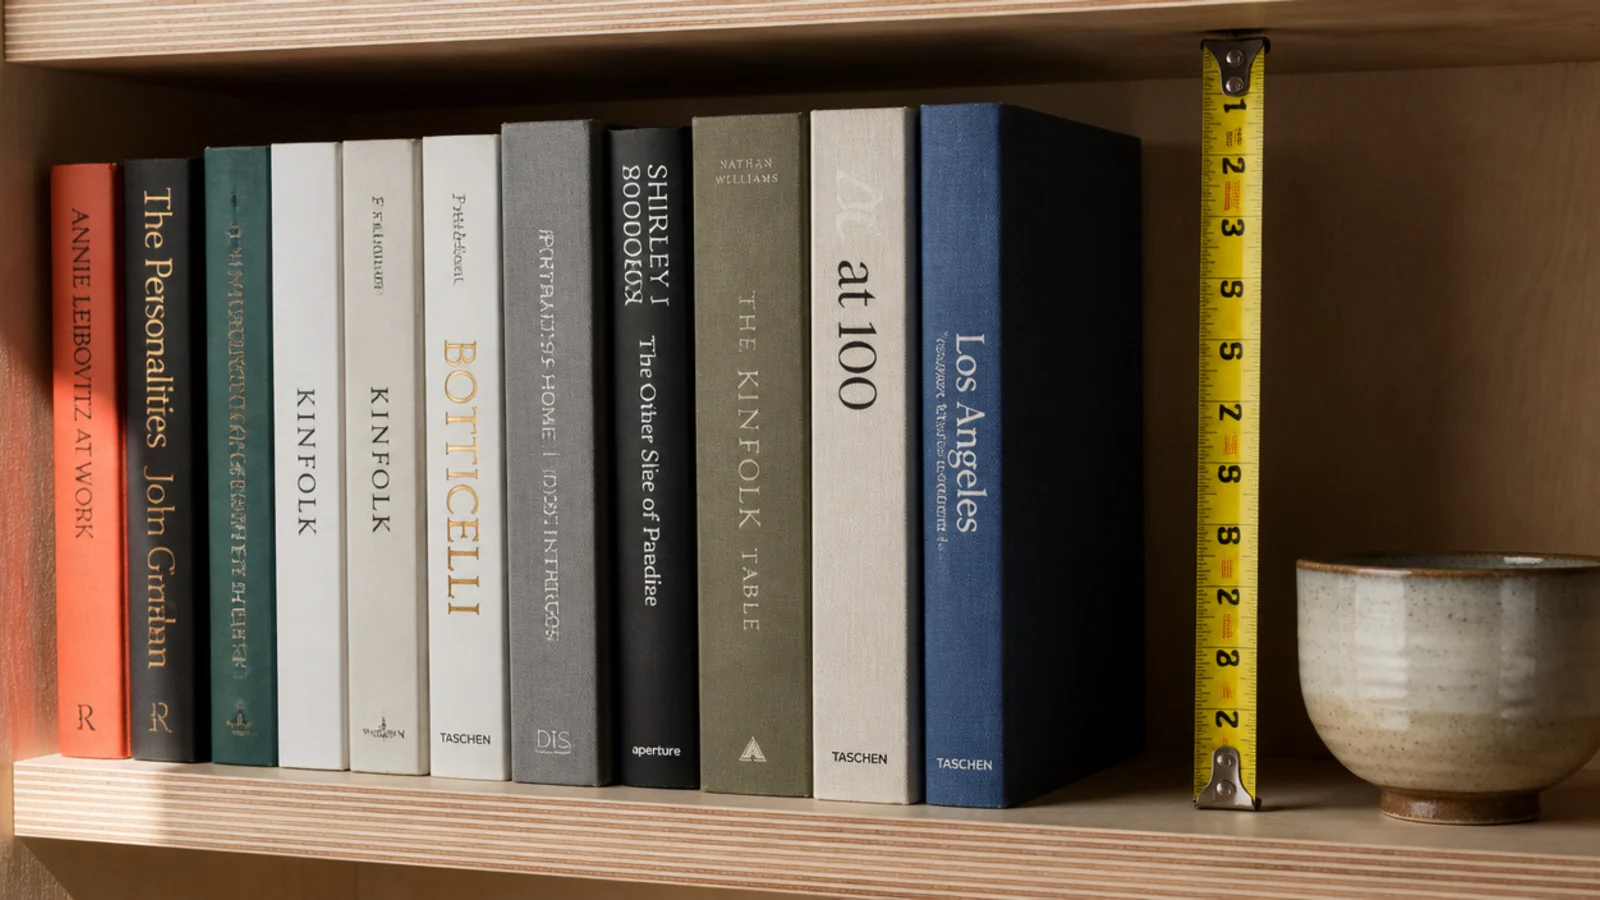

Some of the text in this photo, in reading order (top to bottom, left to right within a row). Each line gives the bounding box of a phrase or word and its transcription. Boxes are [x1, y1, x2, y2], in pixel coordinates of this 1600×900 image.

[1222, 98, 1247, 114] 1
[719, 157, 773, 170] NATHAN
[1222, 157, 1245, 175] 2
[144, 188, 174, 248] The
[648, 165, 670, 288] SHIRLEY
[1221, 219, 1244, 237] 3
[837, 260, 877, 308] at
[71, 207, 94, 539] ANNIE LEIBOVITZ AT WORK
[144, 257, 174, 448] Personalities
[639, 335, 656, 378] The
[837, 321, 878, 411] 100
[370, 387, 391, 533] KINFOLK
[947, 333, 988, 534] Los Angeles
[296, 388, 317, 536] KINFOLK
[444, 340, 480, 616] BOTTICELLI
[736, 292, 761, 631] THE KINFOLK TABLE
[143, 466, 176, 536] John
[643, 498, 661, 522] of
[440, 732, 491, 745] TASCHEN
[631, 745, 681, 758] aperture
[831, 751, 888, 765] TASCHEN
[936, 757, 993, 771] TASCHEN
